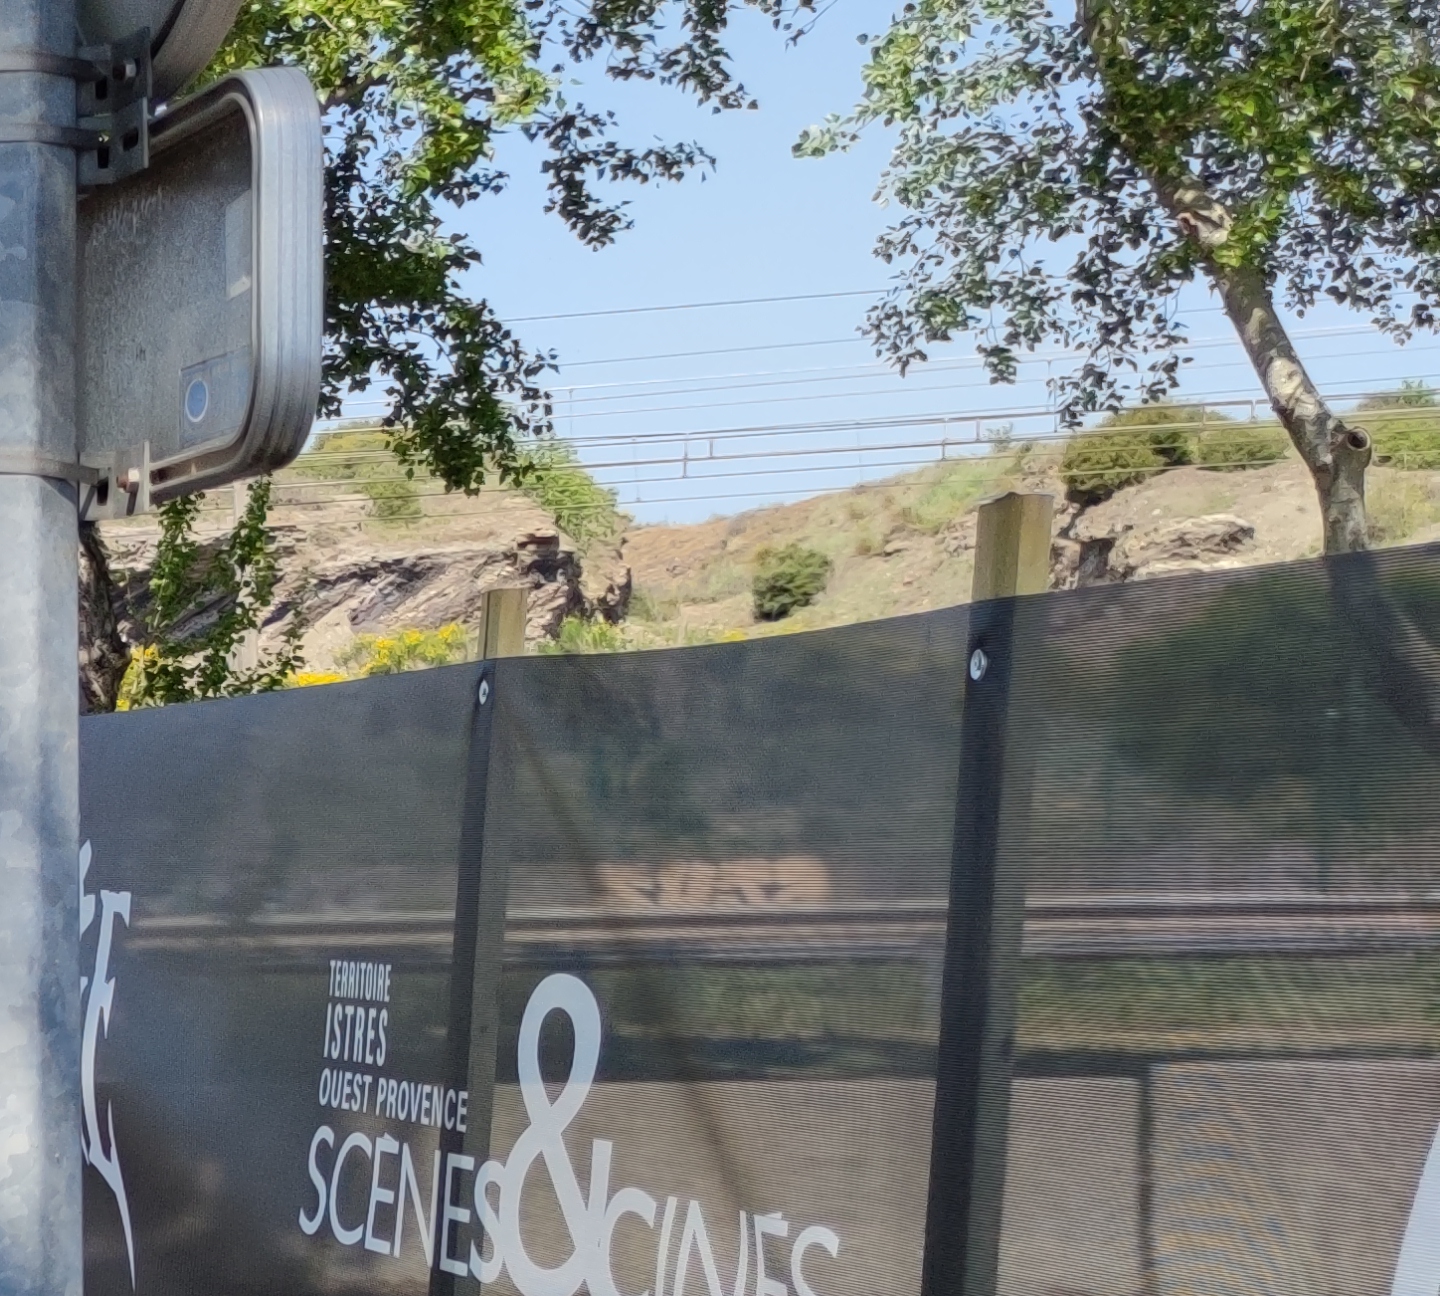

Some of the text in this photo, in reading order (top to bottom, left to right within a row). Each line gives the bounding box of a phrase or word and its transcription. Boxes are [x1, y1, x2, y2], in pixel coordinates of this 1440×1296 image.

[329, 959, 392, 1002] TERRITOIRE
[323, 1002, 389, 1066] ISTRES
[318, 1068, 469, 1133] OUEST PROVENCE
